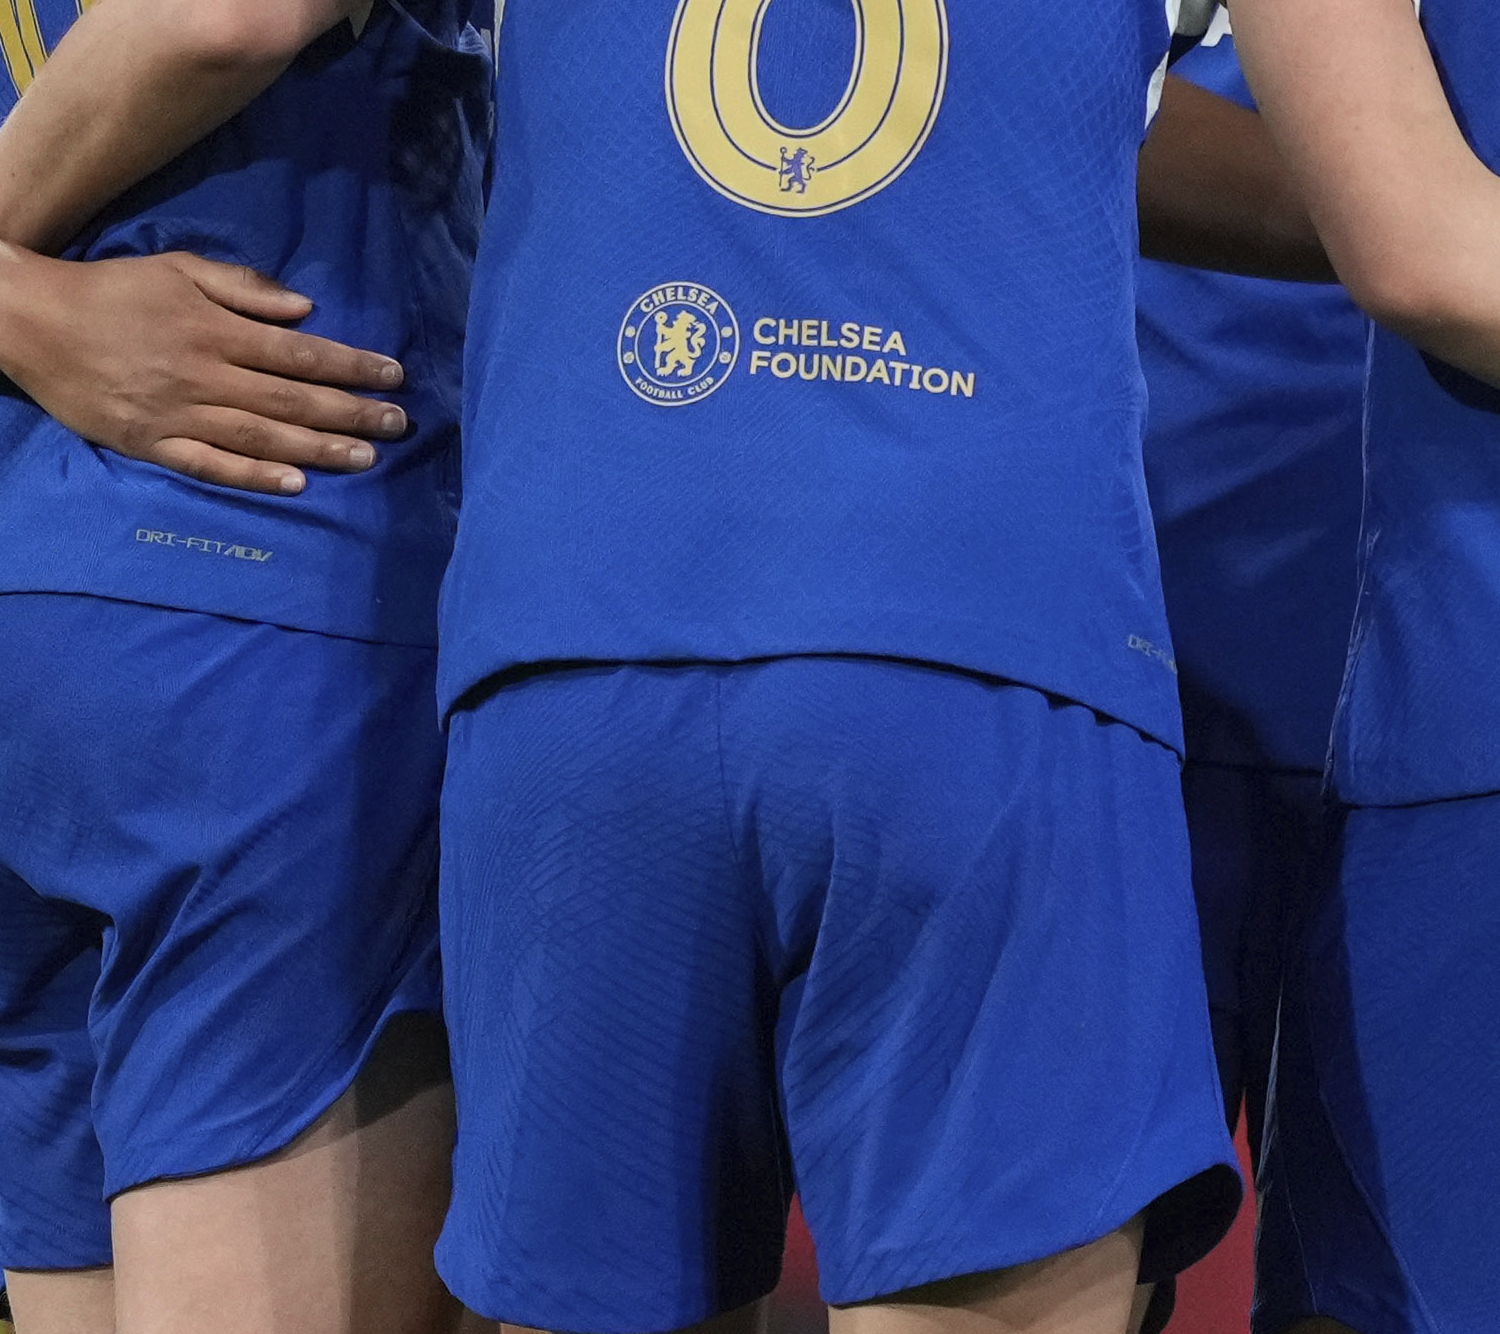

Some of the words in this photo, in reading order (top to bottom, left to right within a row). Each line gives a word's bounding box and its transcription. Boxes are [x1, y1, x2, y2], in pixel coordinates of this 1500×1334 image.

[640, 286, 720, 315] CHELSEA
[753, 317, 907, 356] CHELSEA
[635, 377, 683, 399] FOOTBALL
[687, 376, 714, 396] CLUB
[750, 350, 975, 398] FOUNDATION
